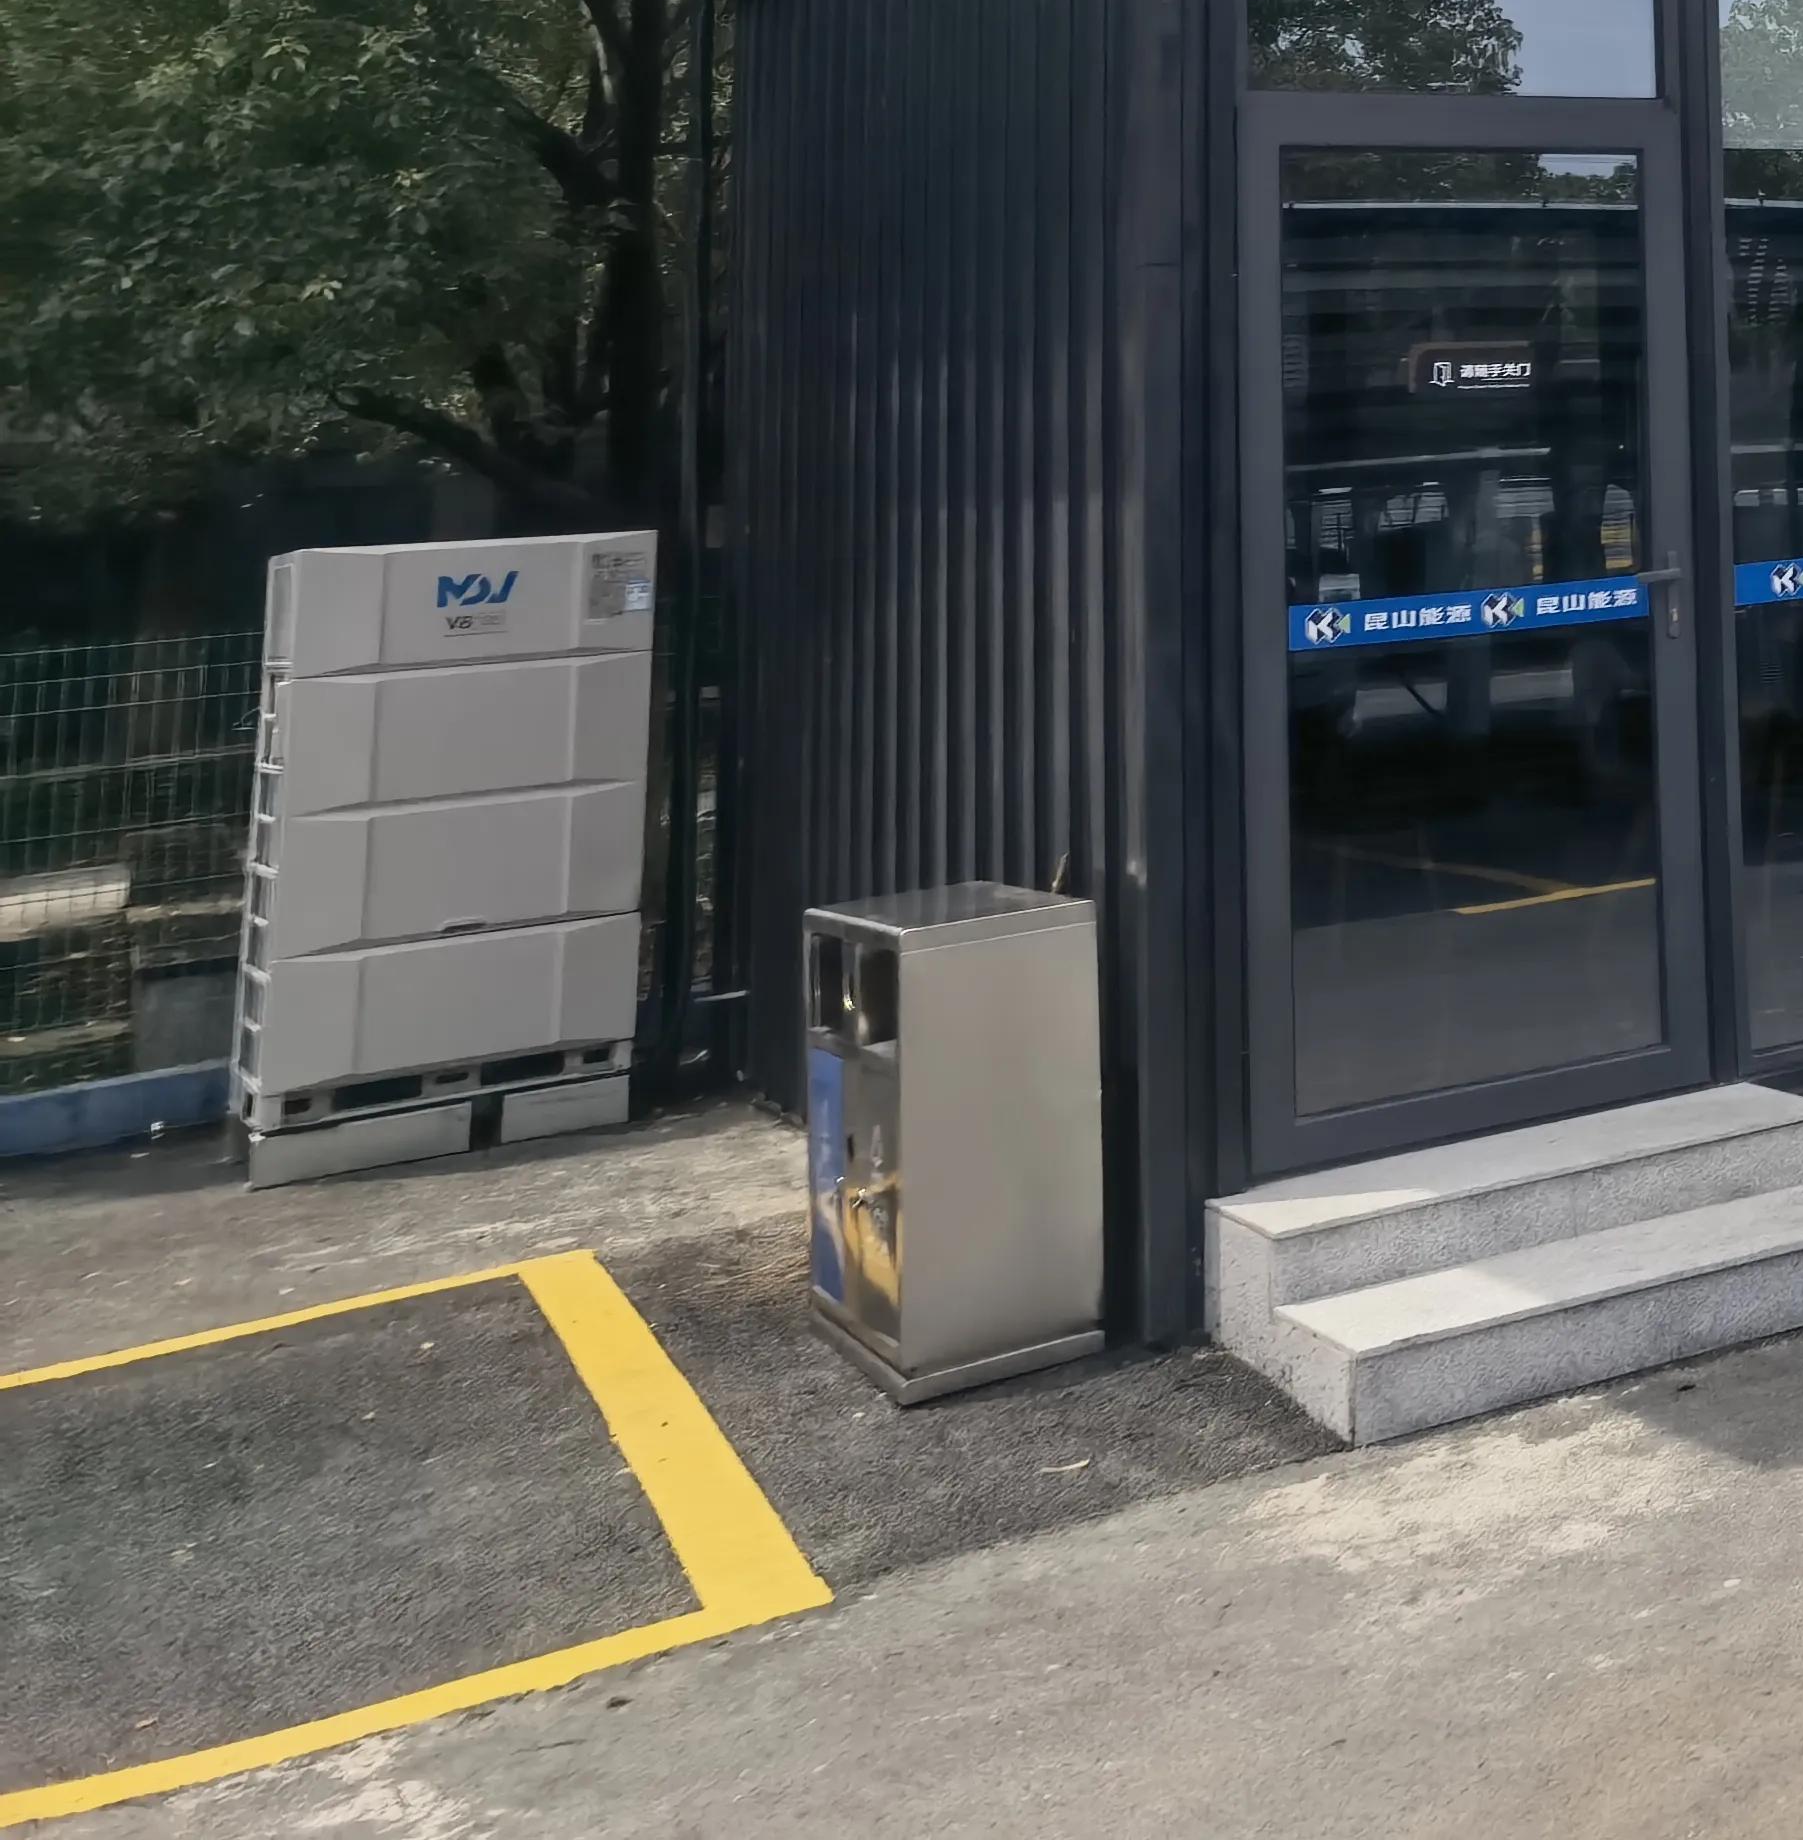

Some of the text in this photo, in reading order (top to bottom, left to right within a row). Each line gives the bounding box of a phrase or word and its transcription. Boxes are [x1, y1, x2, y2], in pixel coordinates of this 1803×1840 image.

[1365, 605, 1471, 630] 昆山能源
[1537, 589, 1637, 614] 昆山能源
